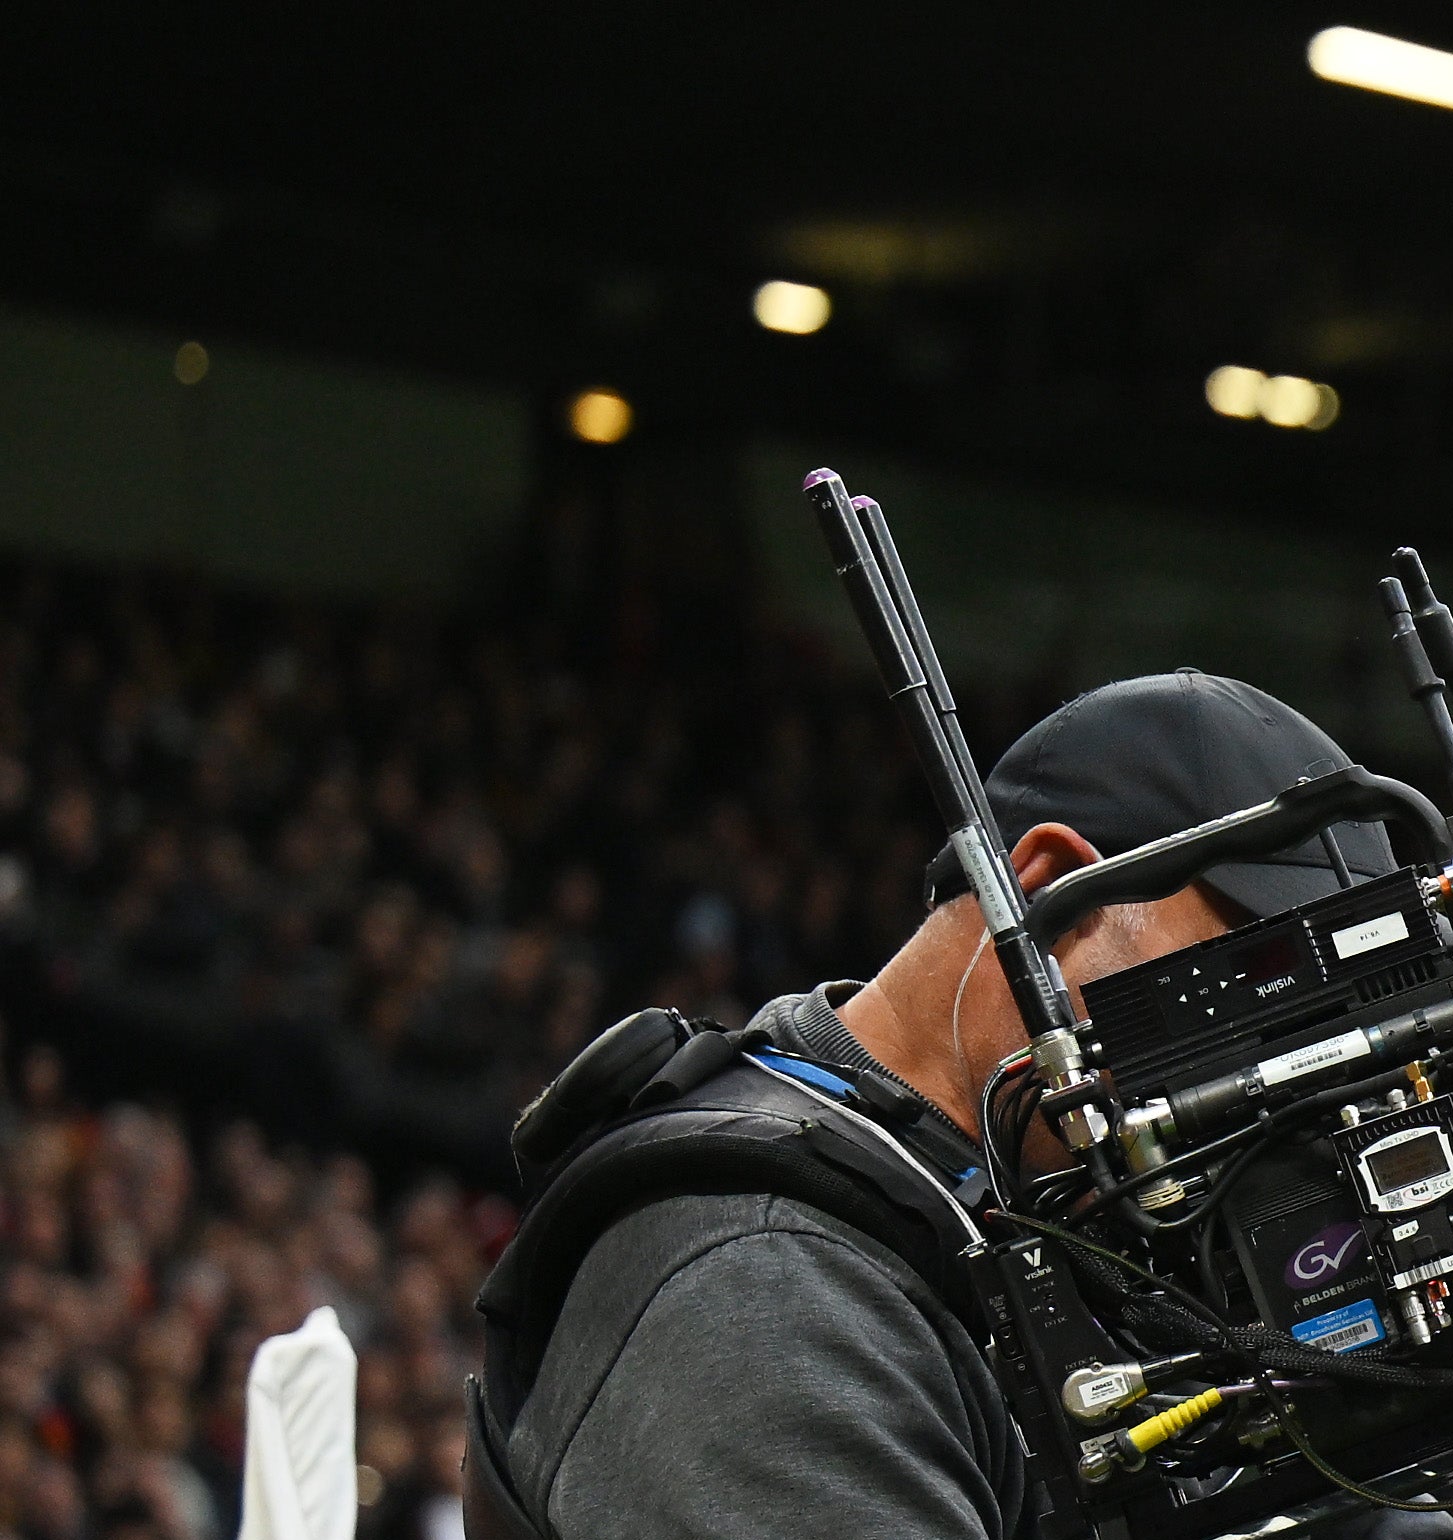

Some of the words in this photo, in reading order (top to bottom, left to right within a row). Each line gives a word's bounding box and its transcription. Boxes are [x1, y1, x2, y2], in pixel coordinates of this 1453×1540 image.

[1255, 975, 1297, 998] vislink
[1403, 1130, 1420, 1140] UHD
[1411, 1182, 1429, 1196] bsi
[1293, 1229, 1362, 1280] GV
[1024, 1264, 1054, 1280] vislink
[1303, 1286, 1345, 1306] BELDEN
